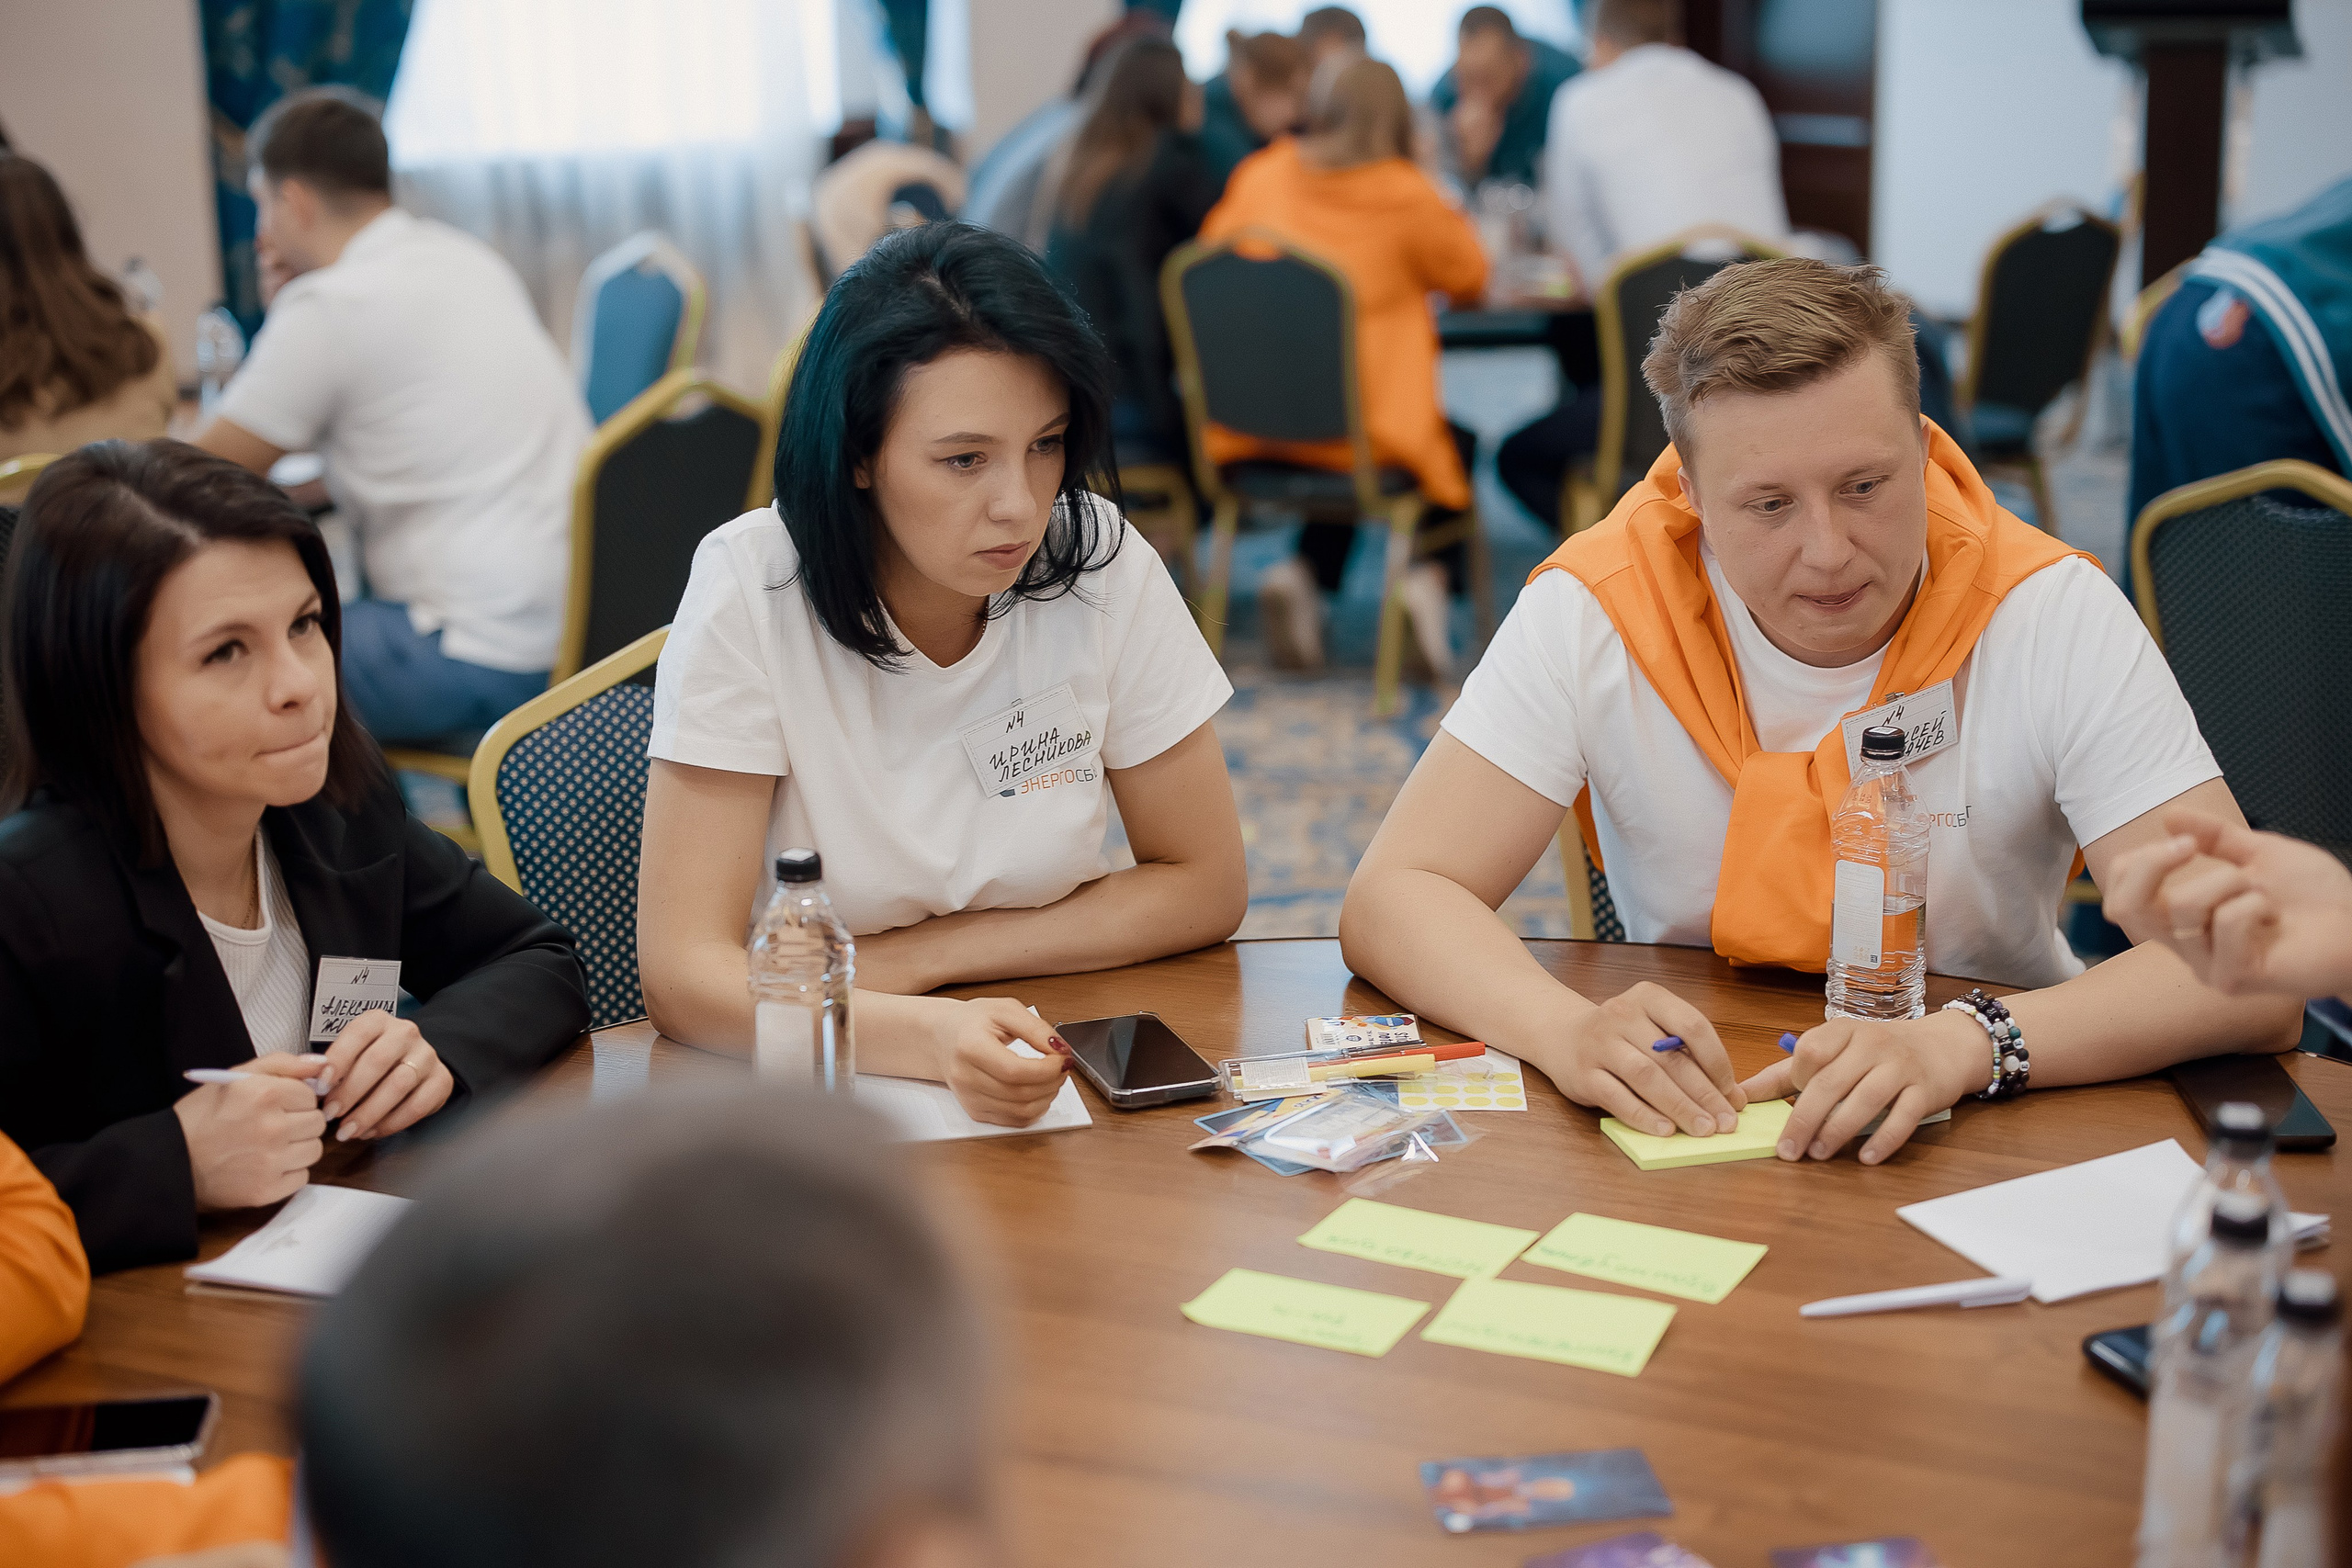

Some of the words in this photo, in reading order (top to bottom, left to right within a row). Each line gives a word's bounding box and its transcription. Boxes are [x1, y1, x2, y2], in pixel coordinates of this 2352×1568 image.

[989, 727, 1060, 771] ИРИНА
[998, 730, 1092, 783] ЛЕСНИКОВА
[1904, 729, 1945, 757] АЧЕВ
